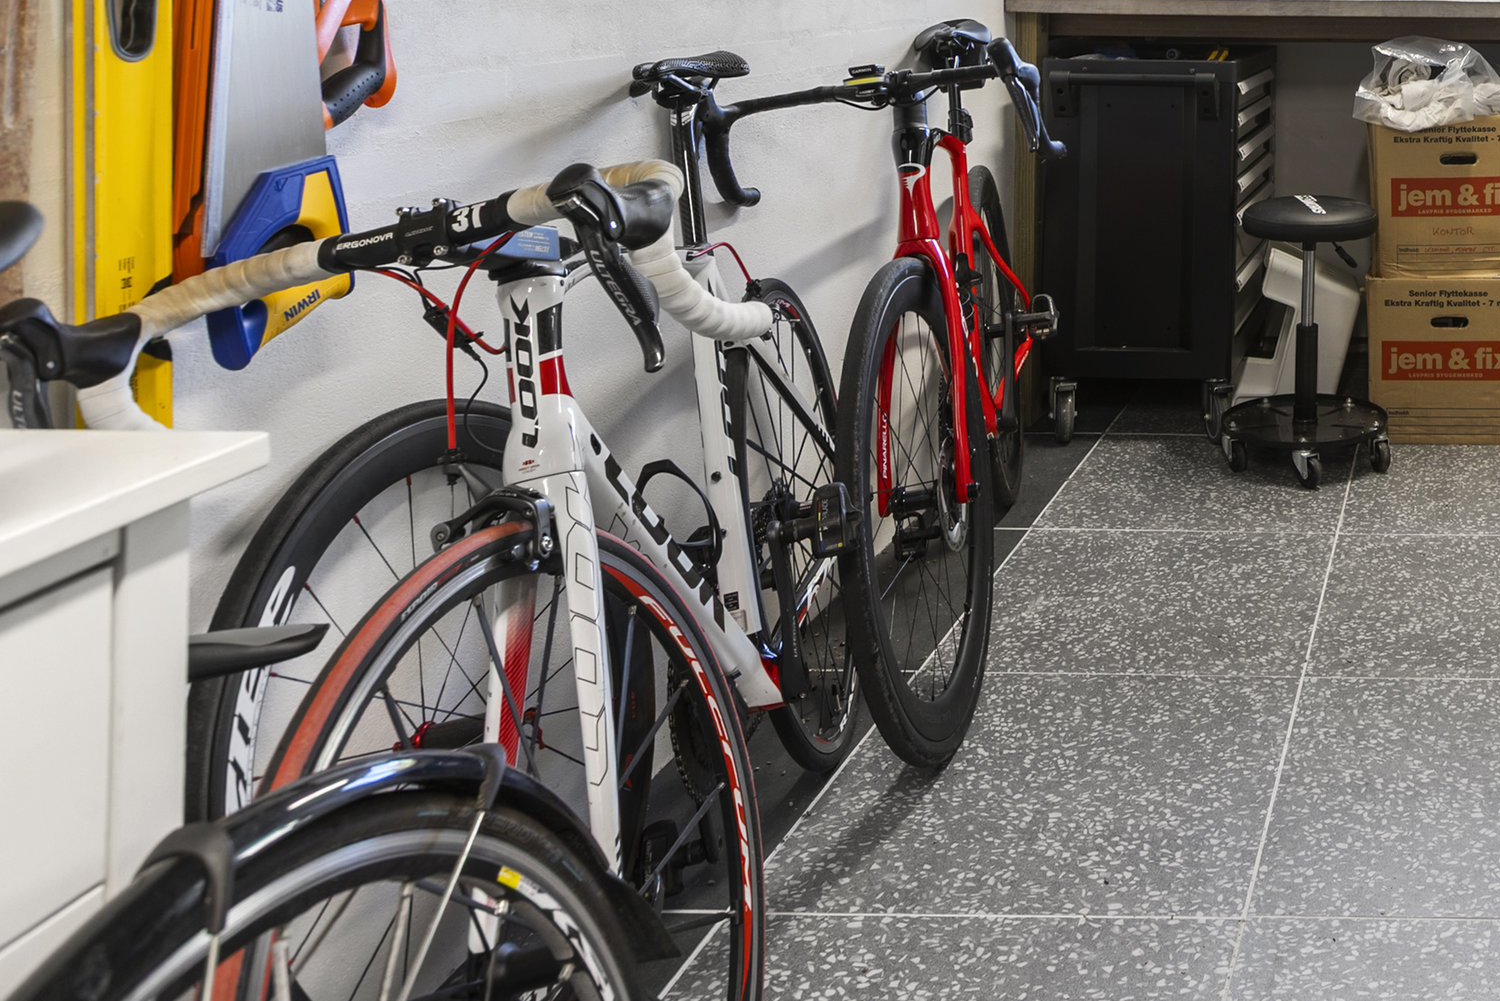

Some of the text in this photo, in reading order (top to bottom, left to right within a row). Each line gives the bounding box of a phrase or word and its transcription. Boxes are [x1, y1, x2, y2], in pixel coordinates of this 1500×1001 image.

[1393, 136, 1421, 144] Ekstra
[1423, 135, 1453, 145] Kraftig
[1455, 135, 1489, 144] Kvalitet
[1447, 125, 1497, 135] Flyttekasse
[1397, 184, 1452, 211] jem
[1457, 183, 1480, 206] &
[451, 202, 486, 233] 3T
[336, 231, 393, 251] ERGONOVA
[1432, 226, 1475, 236] KONTOR
[590, 249, 642, 327] ULTEGRA
[1408, 289, 1489, 299] Senior Flyttekasse
[283, 288, 321, 322] IRWIN
[1384, 299, 1412, 307] Ekstra
[1414, 299, 1445, 308] Kraftig
[1446, 299, 1481, 307] Kvalitet
[1388, 347, 1443, 374] jem
[1447, 347, 1471, 370] &
[510, 296, 539, 449] LOOK
